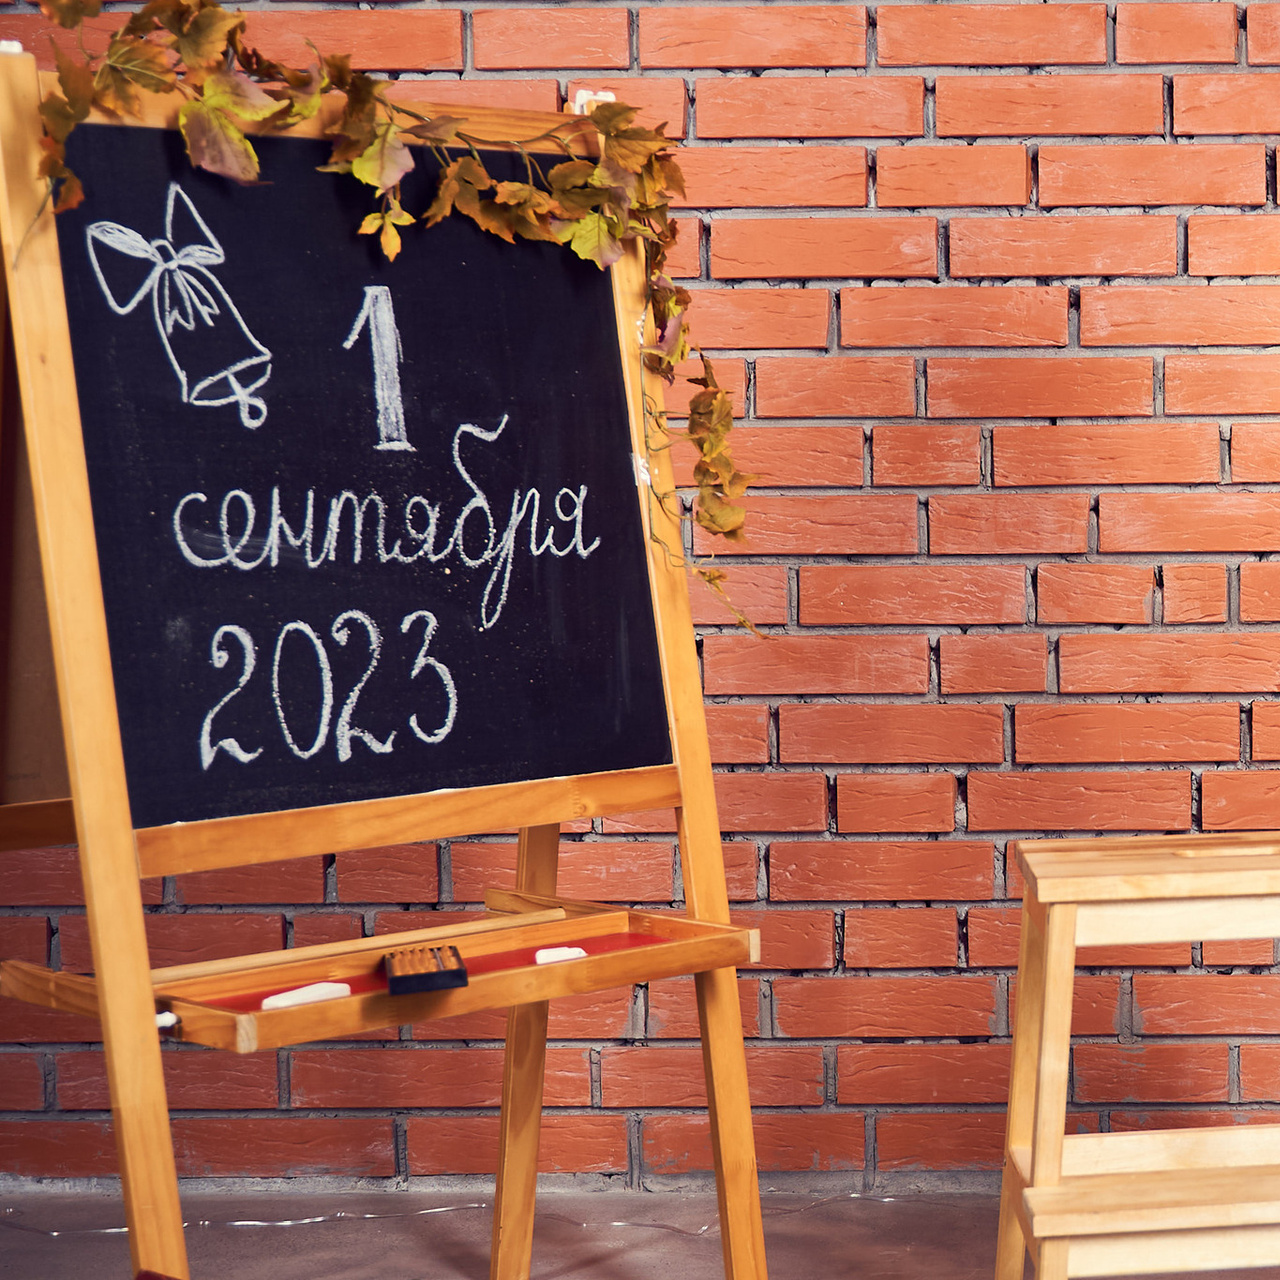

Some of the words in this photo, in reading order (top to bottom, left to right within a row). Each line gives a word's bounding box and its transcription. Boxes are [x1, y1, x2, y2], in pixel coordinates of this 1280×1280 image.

[342, 285, 418, 453] 1
[172, 413, 602, 631] сентября
[199, 608, 460, 772] 2023
